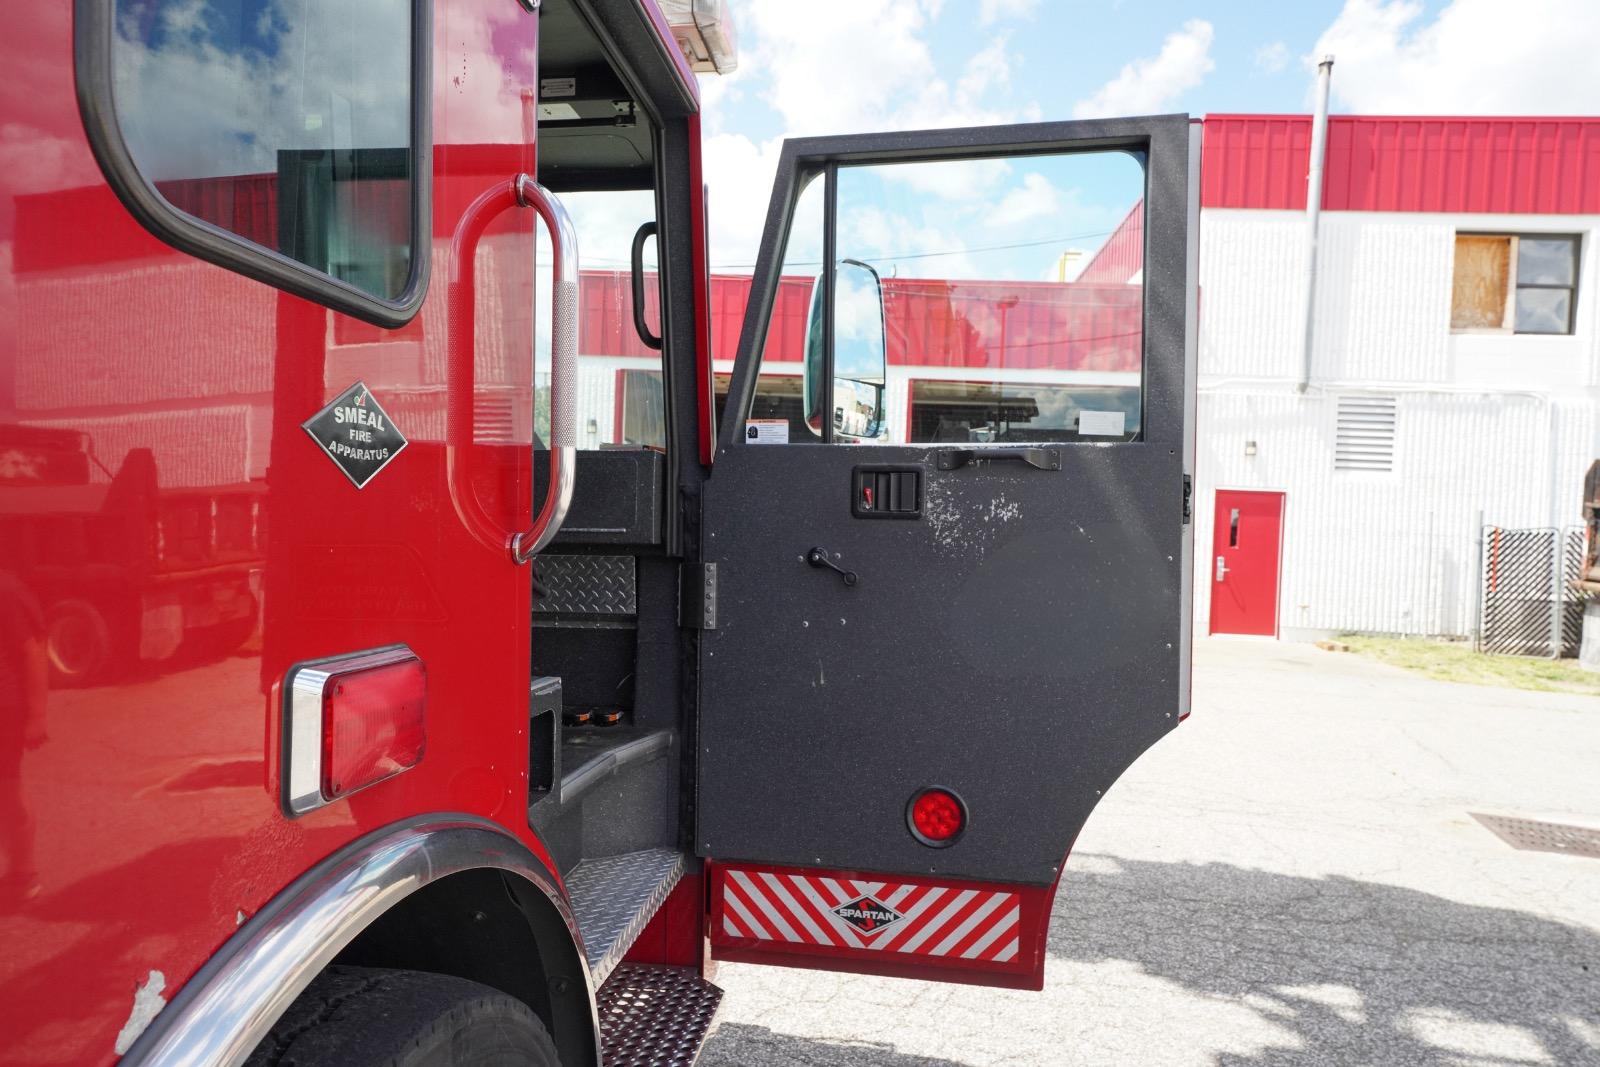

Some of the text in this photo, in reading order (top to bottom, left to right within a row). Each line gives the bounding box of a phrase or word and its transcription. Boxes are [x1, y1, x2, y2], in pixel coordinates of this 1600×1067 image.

[334, 407, 384, 431] SMEAL
[350, 429, 372, 442] FIRE
[329, 440, 388, 460] APPARATUS
[839, 908, 894, 921] SPARTAN
